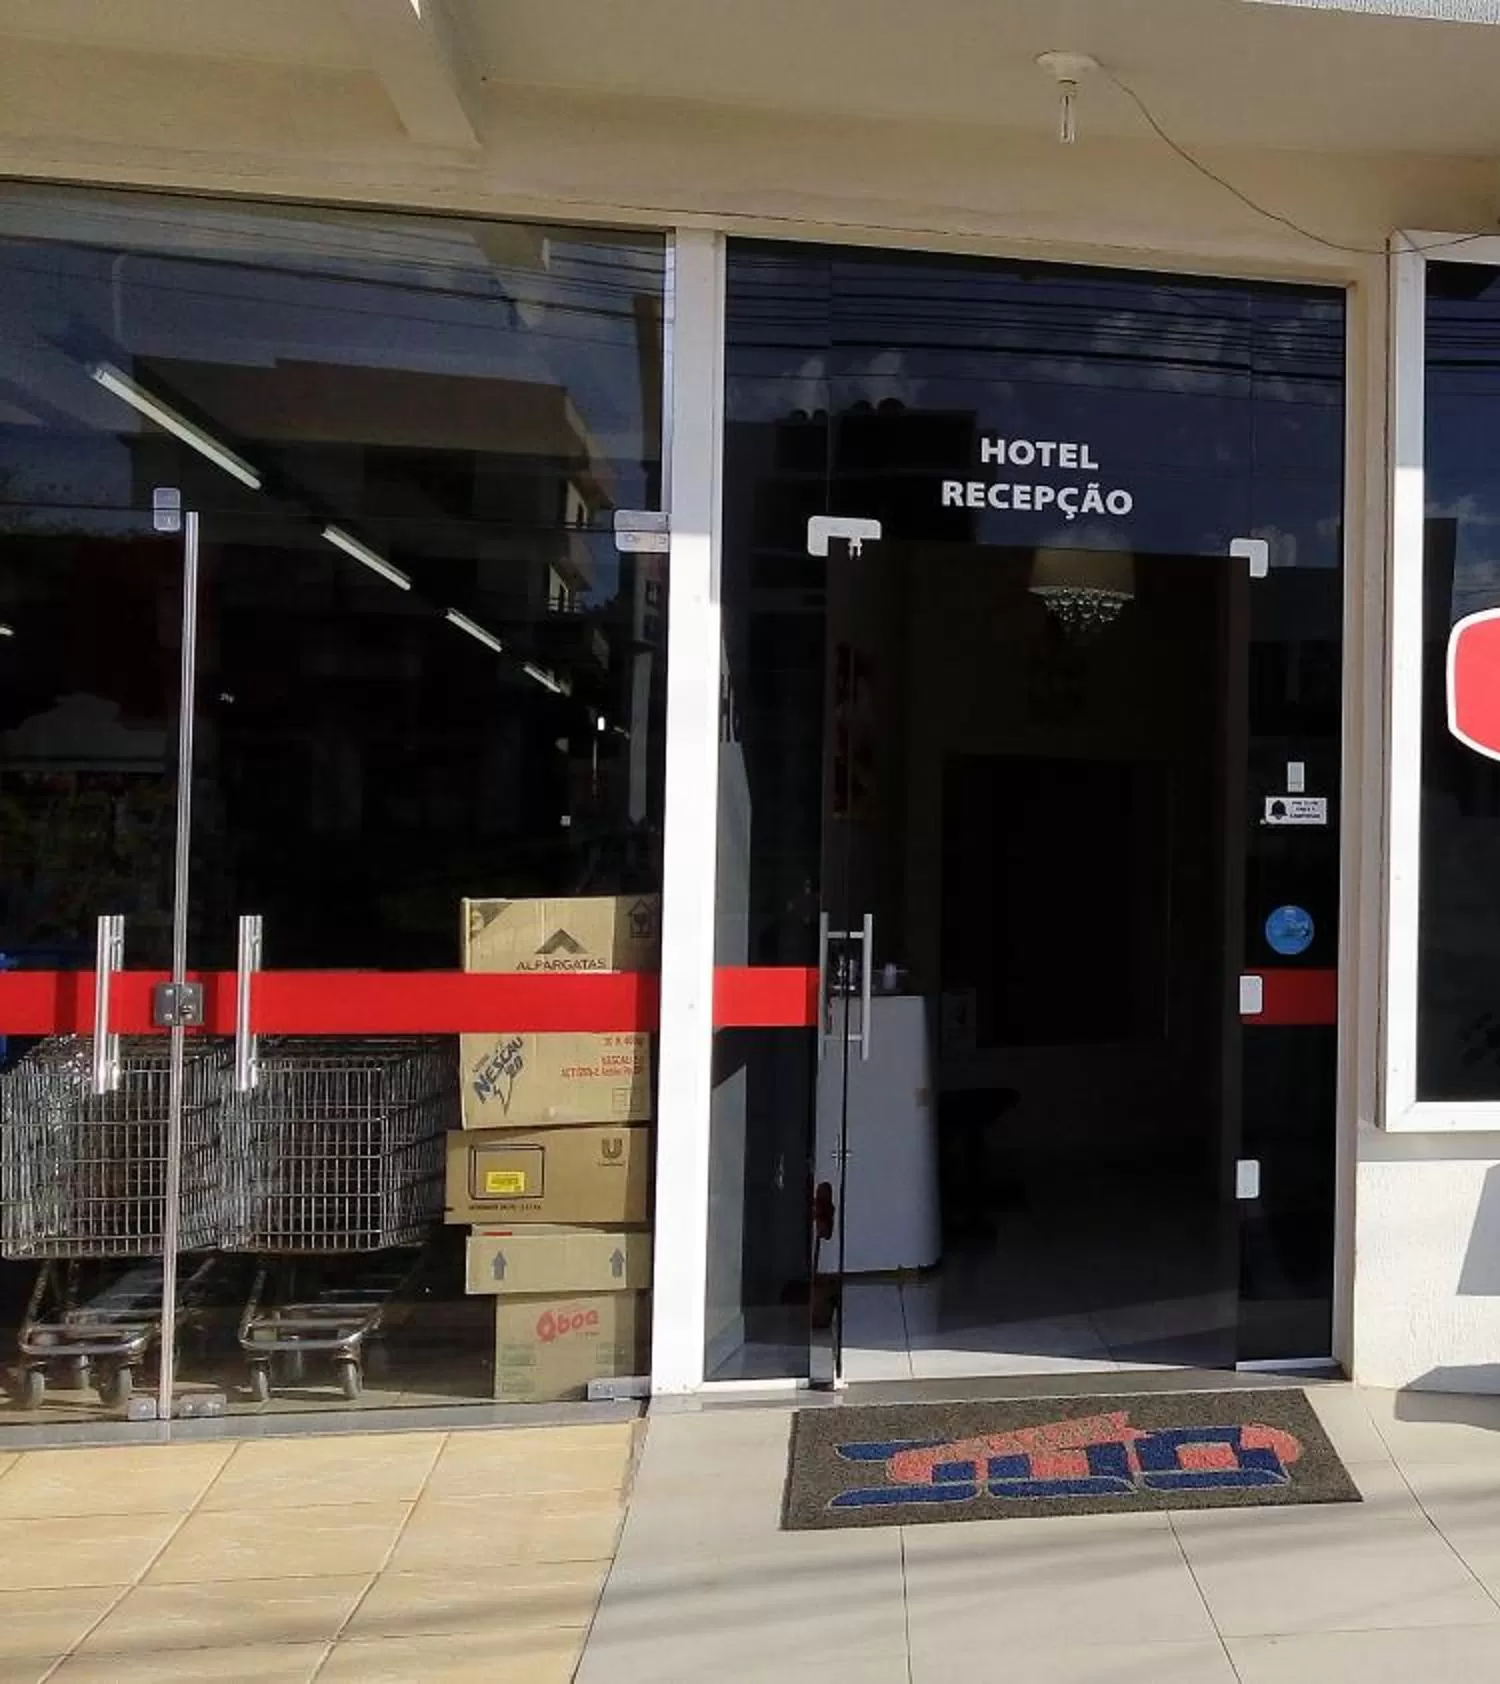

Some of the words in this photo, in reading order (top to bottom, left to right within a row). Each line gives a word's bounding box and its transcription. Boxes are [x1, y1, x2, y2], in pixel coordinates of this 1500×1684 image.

[981, 438, 1100, 469] HOTEL
[942, 481, 1133, 519] RECEPÇÃO
[515, 958, 607, 972] ALPARGATAS
[472, 1036, 524, 1105] NESCAU
[535, 1310, 600, 1344] Qboa
